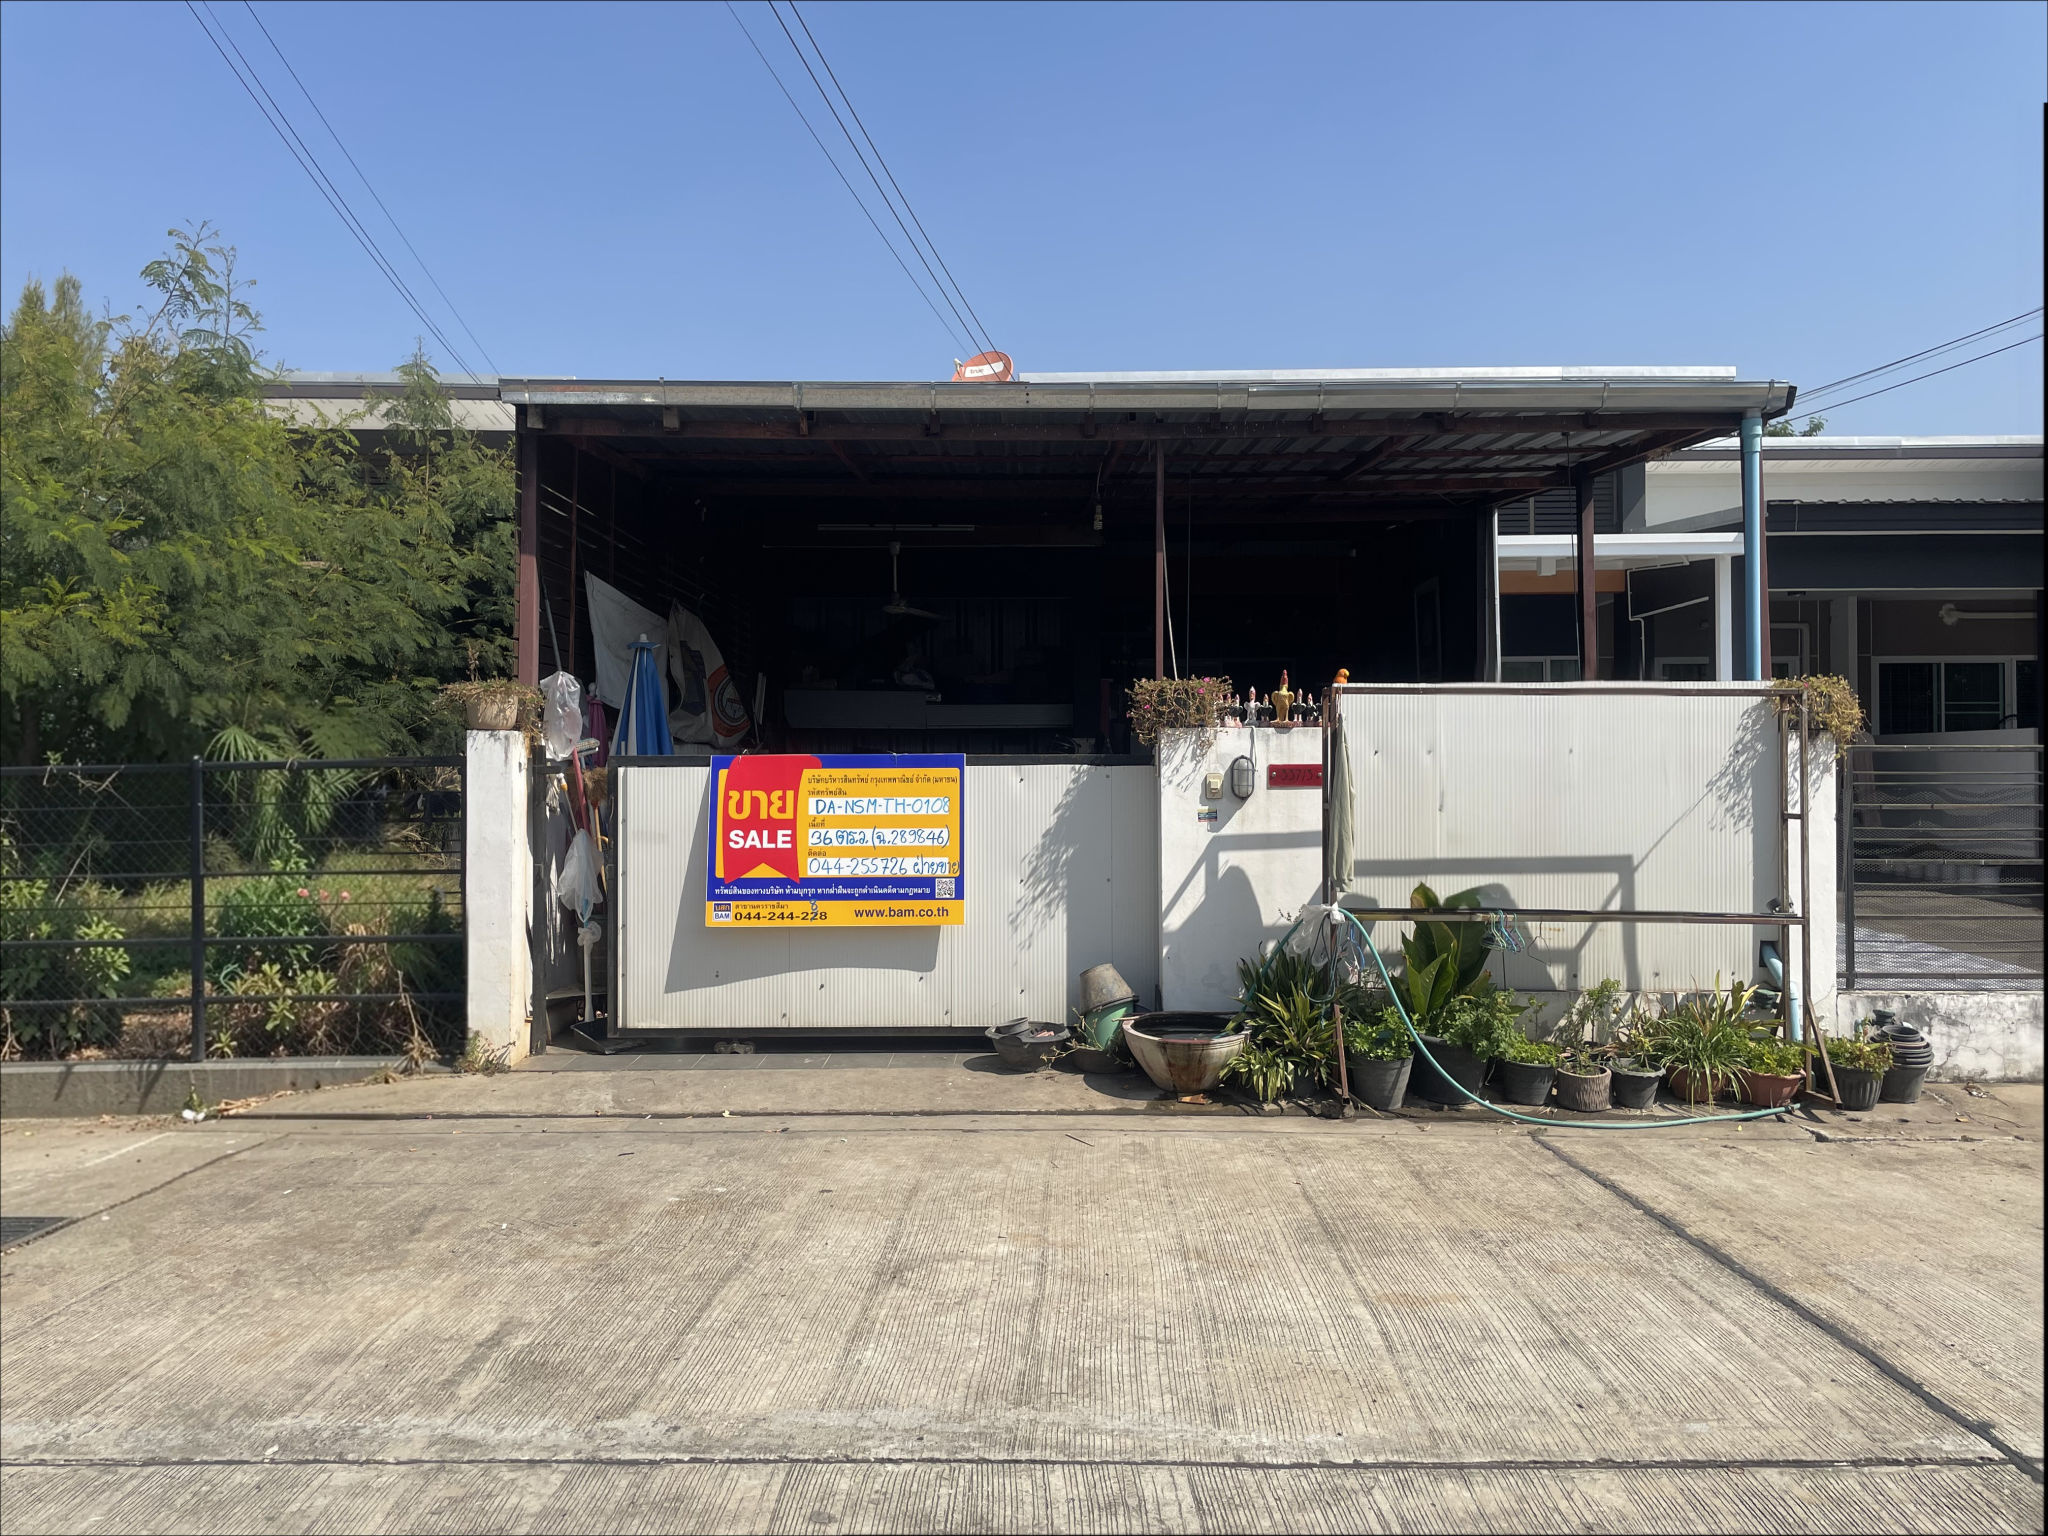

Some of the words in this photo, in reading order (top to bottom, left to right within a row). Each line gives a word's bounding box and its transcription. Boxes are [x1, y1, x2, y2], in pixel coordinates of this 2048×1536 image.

[807, 774, 869, 784] บริษัทบริหารสินทรัพย์
[870, 774, 914, 787] กรุงเทพพาณิชย์
[915, 775, 931, 784] จำกัด
[932, 775, 958, 785] (มหาชน)
[807, 787, 847, 797] รหัสทรัพย์สิน
[727, 789, 795, 820] ขาย
[815, 796, 951, 815] DA-NSM-TH-0108
[728, 829, 793, 850] SALE
[810, 830, 833, 846] 36
[807, 848, 827, 857] ติดต่อ
[809, 857, 908, 876] 044-255726
[714, 885, 784, 895] ทรัพย์สินของทางบริษัท
[785, 885, 816, 897] ห้ามบุกรุก
[734, 911, 828, 921] 044-244-228
[854, 906, 950, 918] www.bam.co.th
